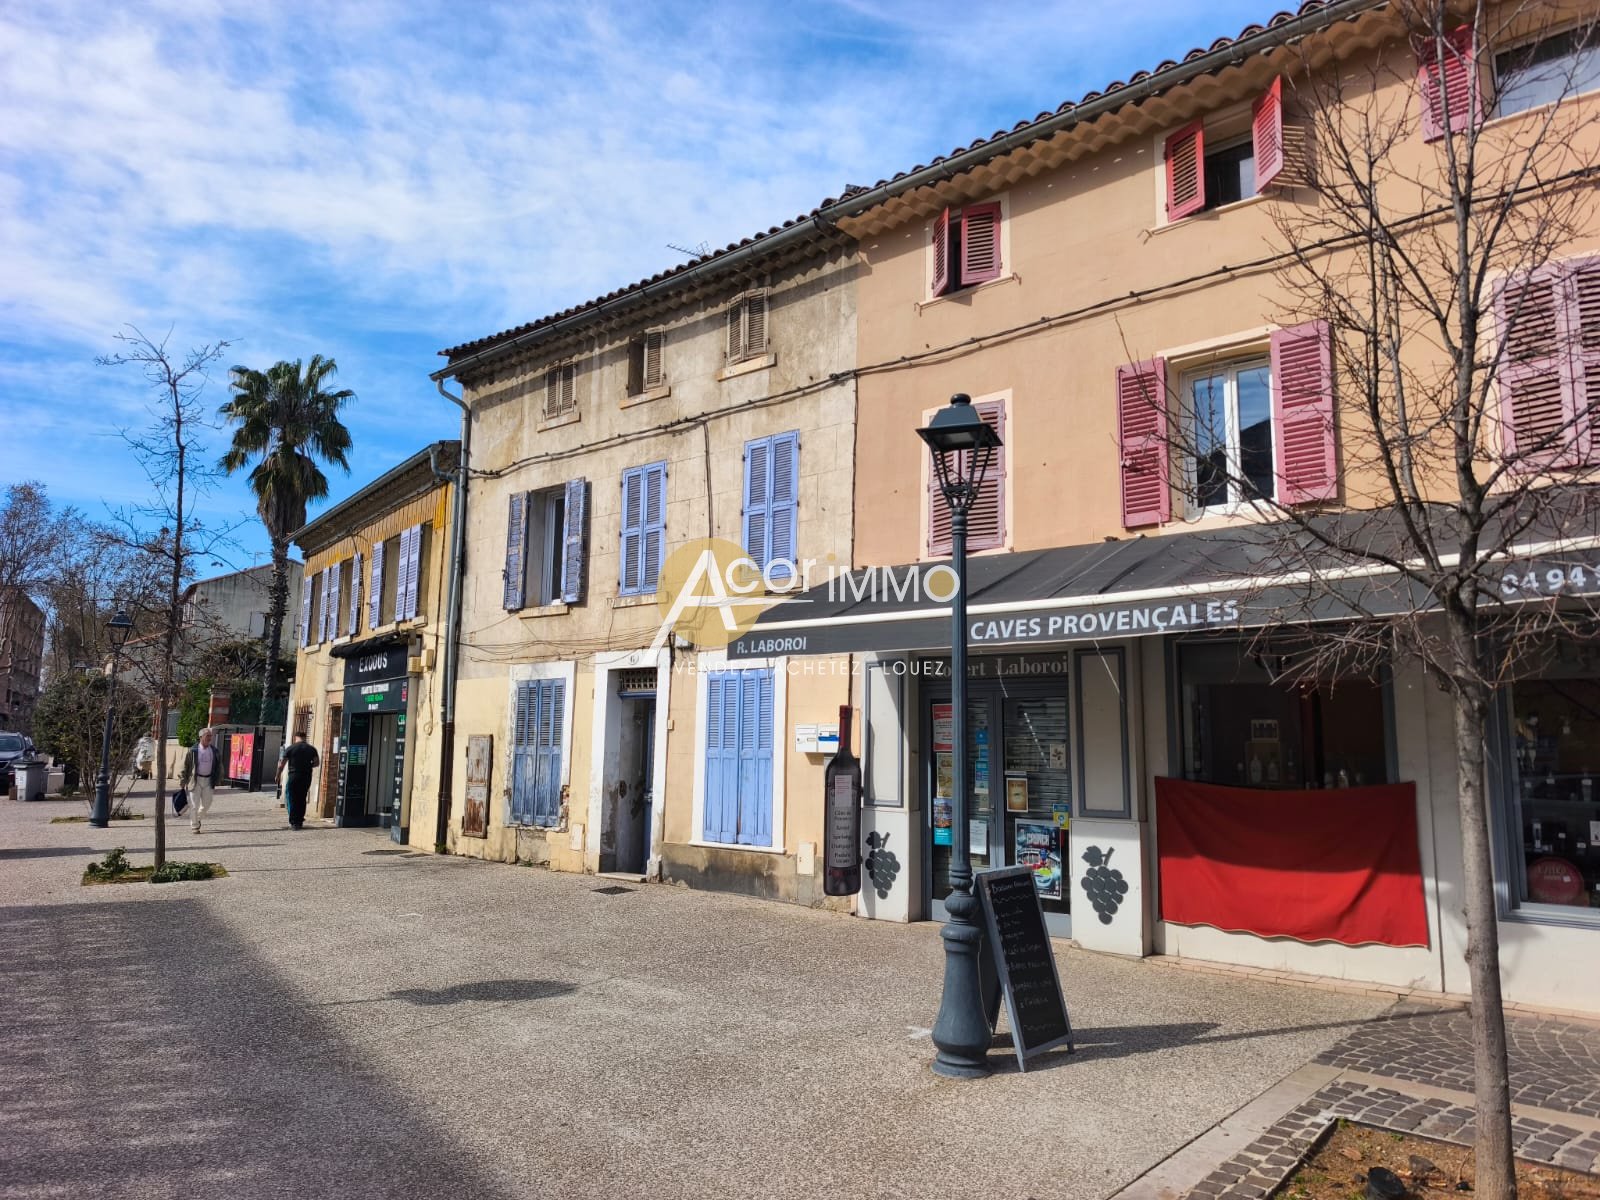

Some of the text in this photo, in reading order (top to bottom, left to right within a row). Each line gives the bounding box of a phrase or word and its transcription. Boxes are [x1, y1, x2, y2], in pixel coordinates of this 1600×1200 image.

[1546, 566, 1587, 590] 94
[970, 599, 1239, 641] CAVES PROVENÇALES
[736, 637, 807, 654] R. LABOROI
[996, 655, 1068, 675] Laboroi
